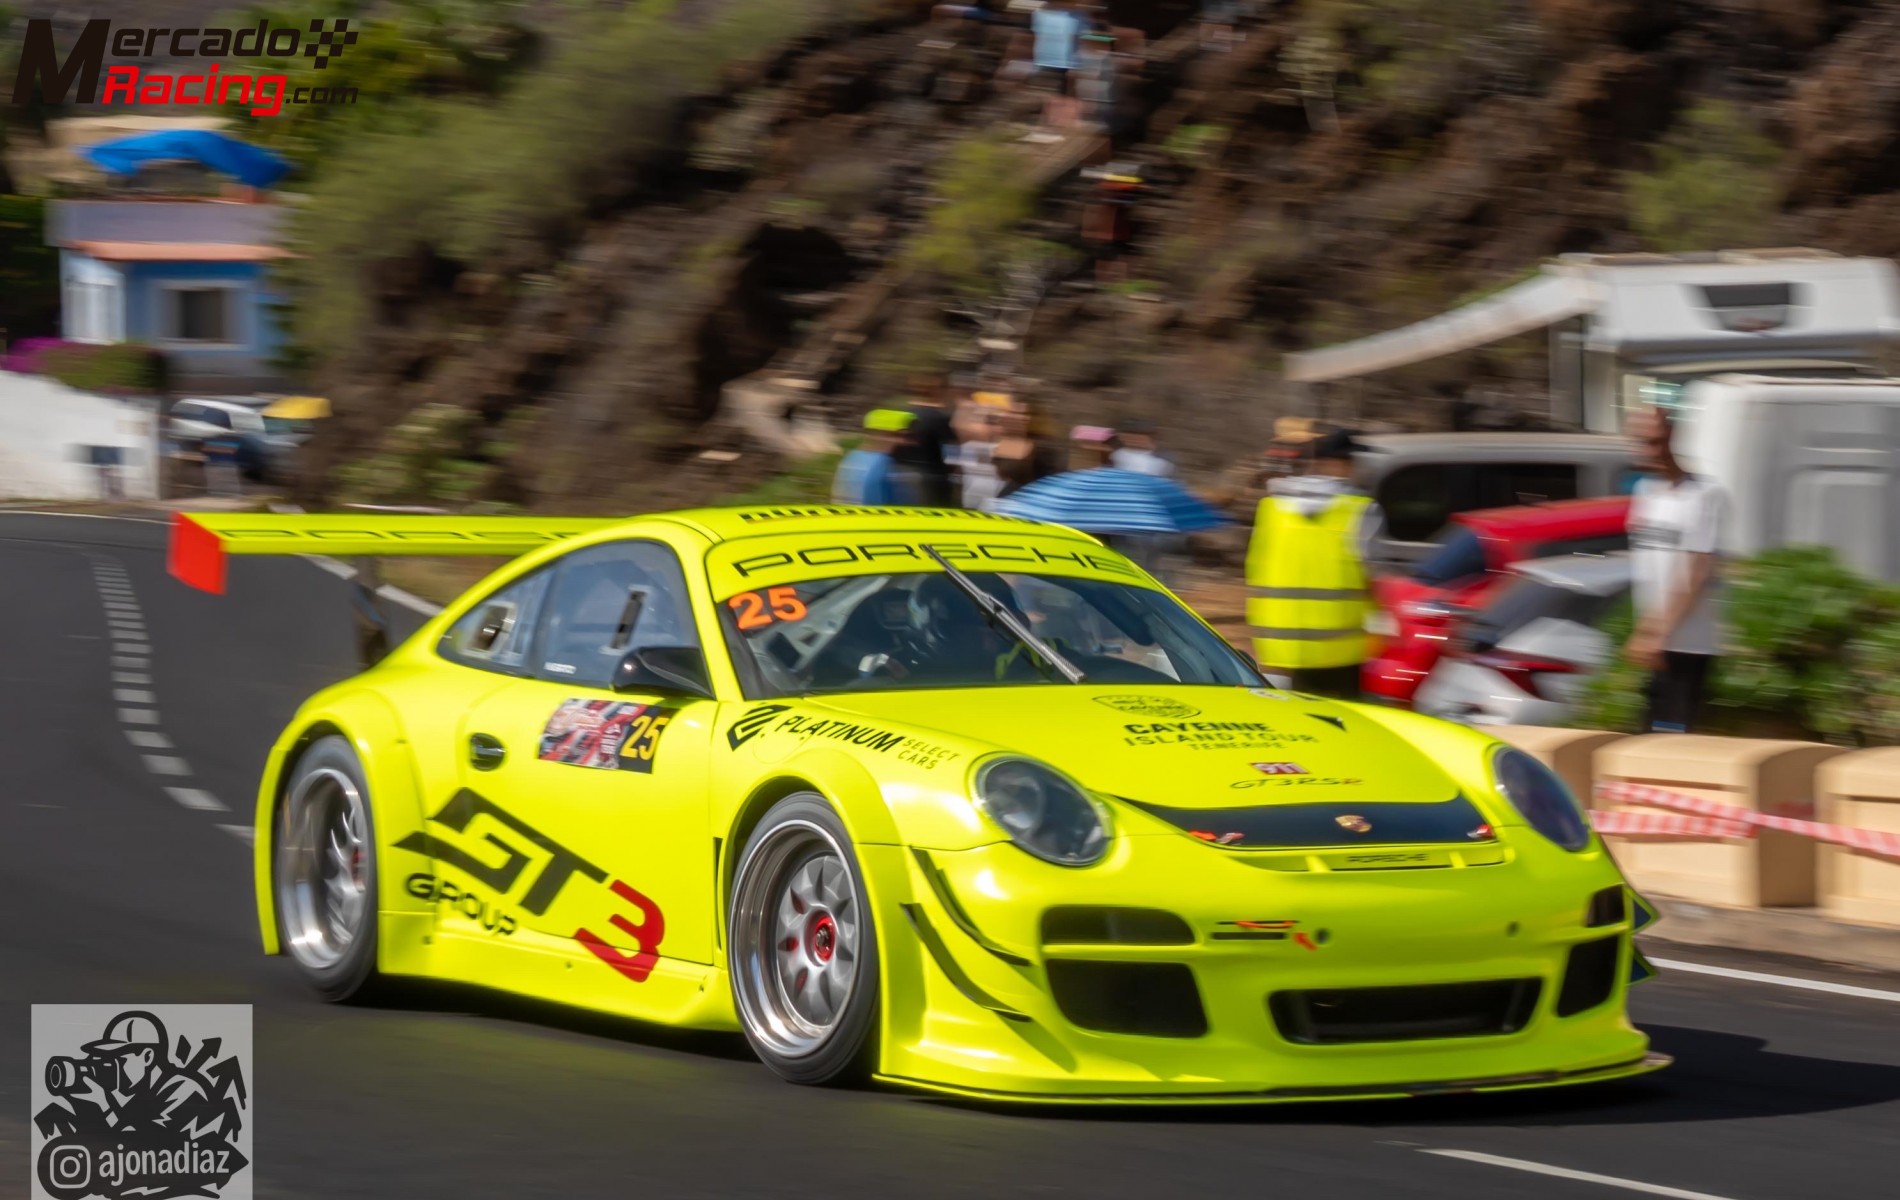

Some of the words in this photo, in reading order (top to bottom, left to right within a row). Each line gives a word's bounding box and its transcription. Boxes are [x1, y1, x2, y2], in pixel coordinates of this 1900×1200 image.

[731, 543, 1142, 579] PORSCHE
[728, 586, 808, 631] 25
[619, 715, 671, 760] 25
[774, 715, 906, 752] PLATINUM
[1123, 722, 1275, 734] CAYENNE
[1123, 733, 1235, 746] ISLAND
[1239, 732, 1321, 743] TOUR
[897, 749, 938, 770] CARS
[903, 738, 961, 761] SELECT
[405, 872, 518, 936] GROUP
